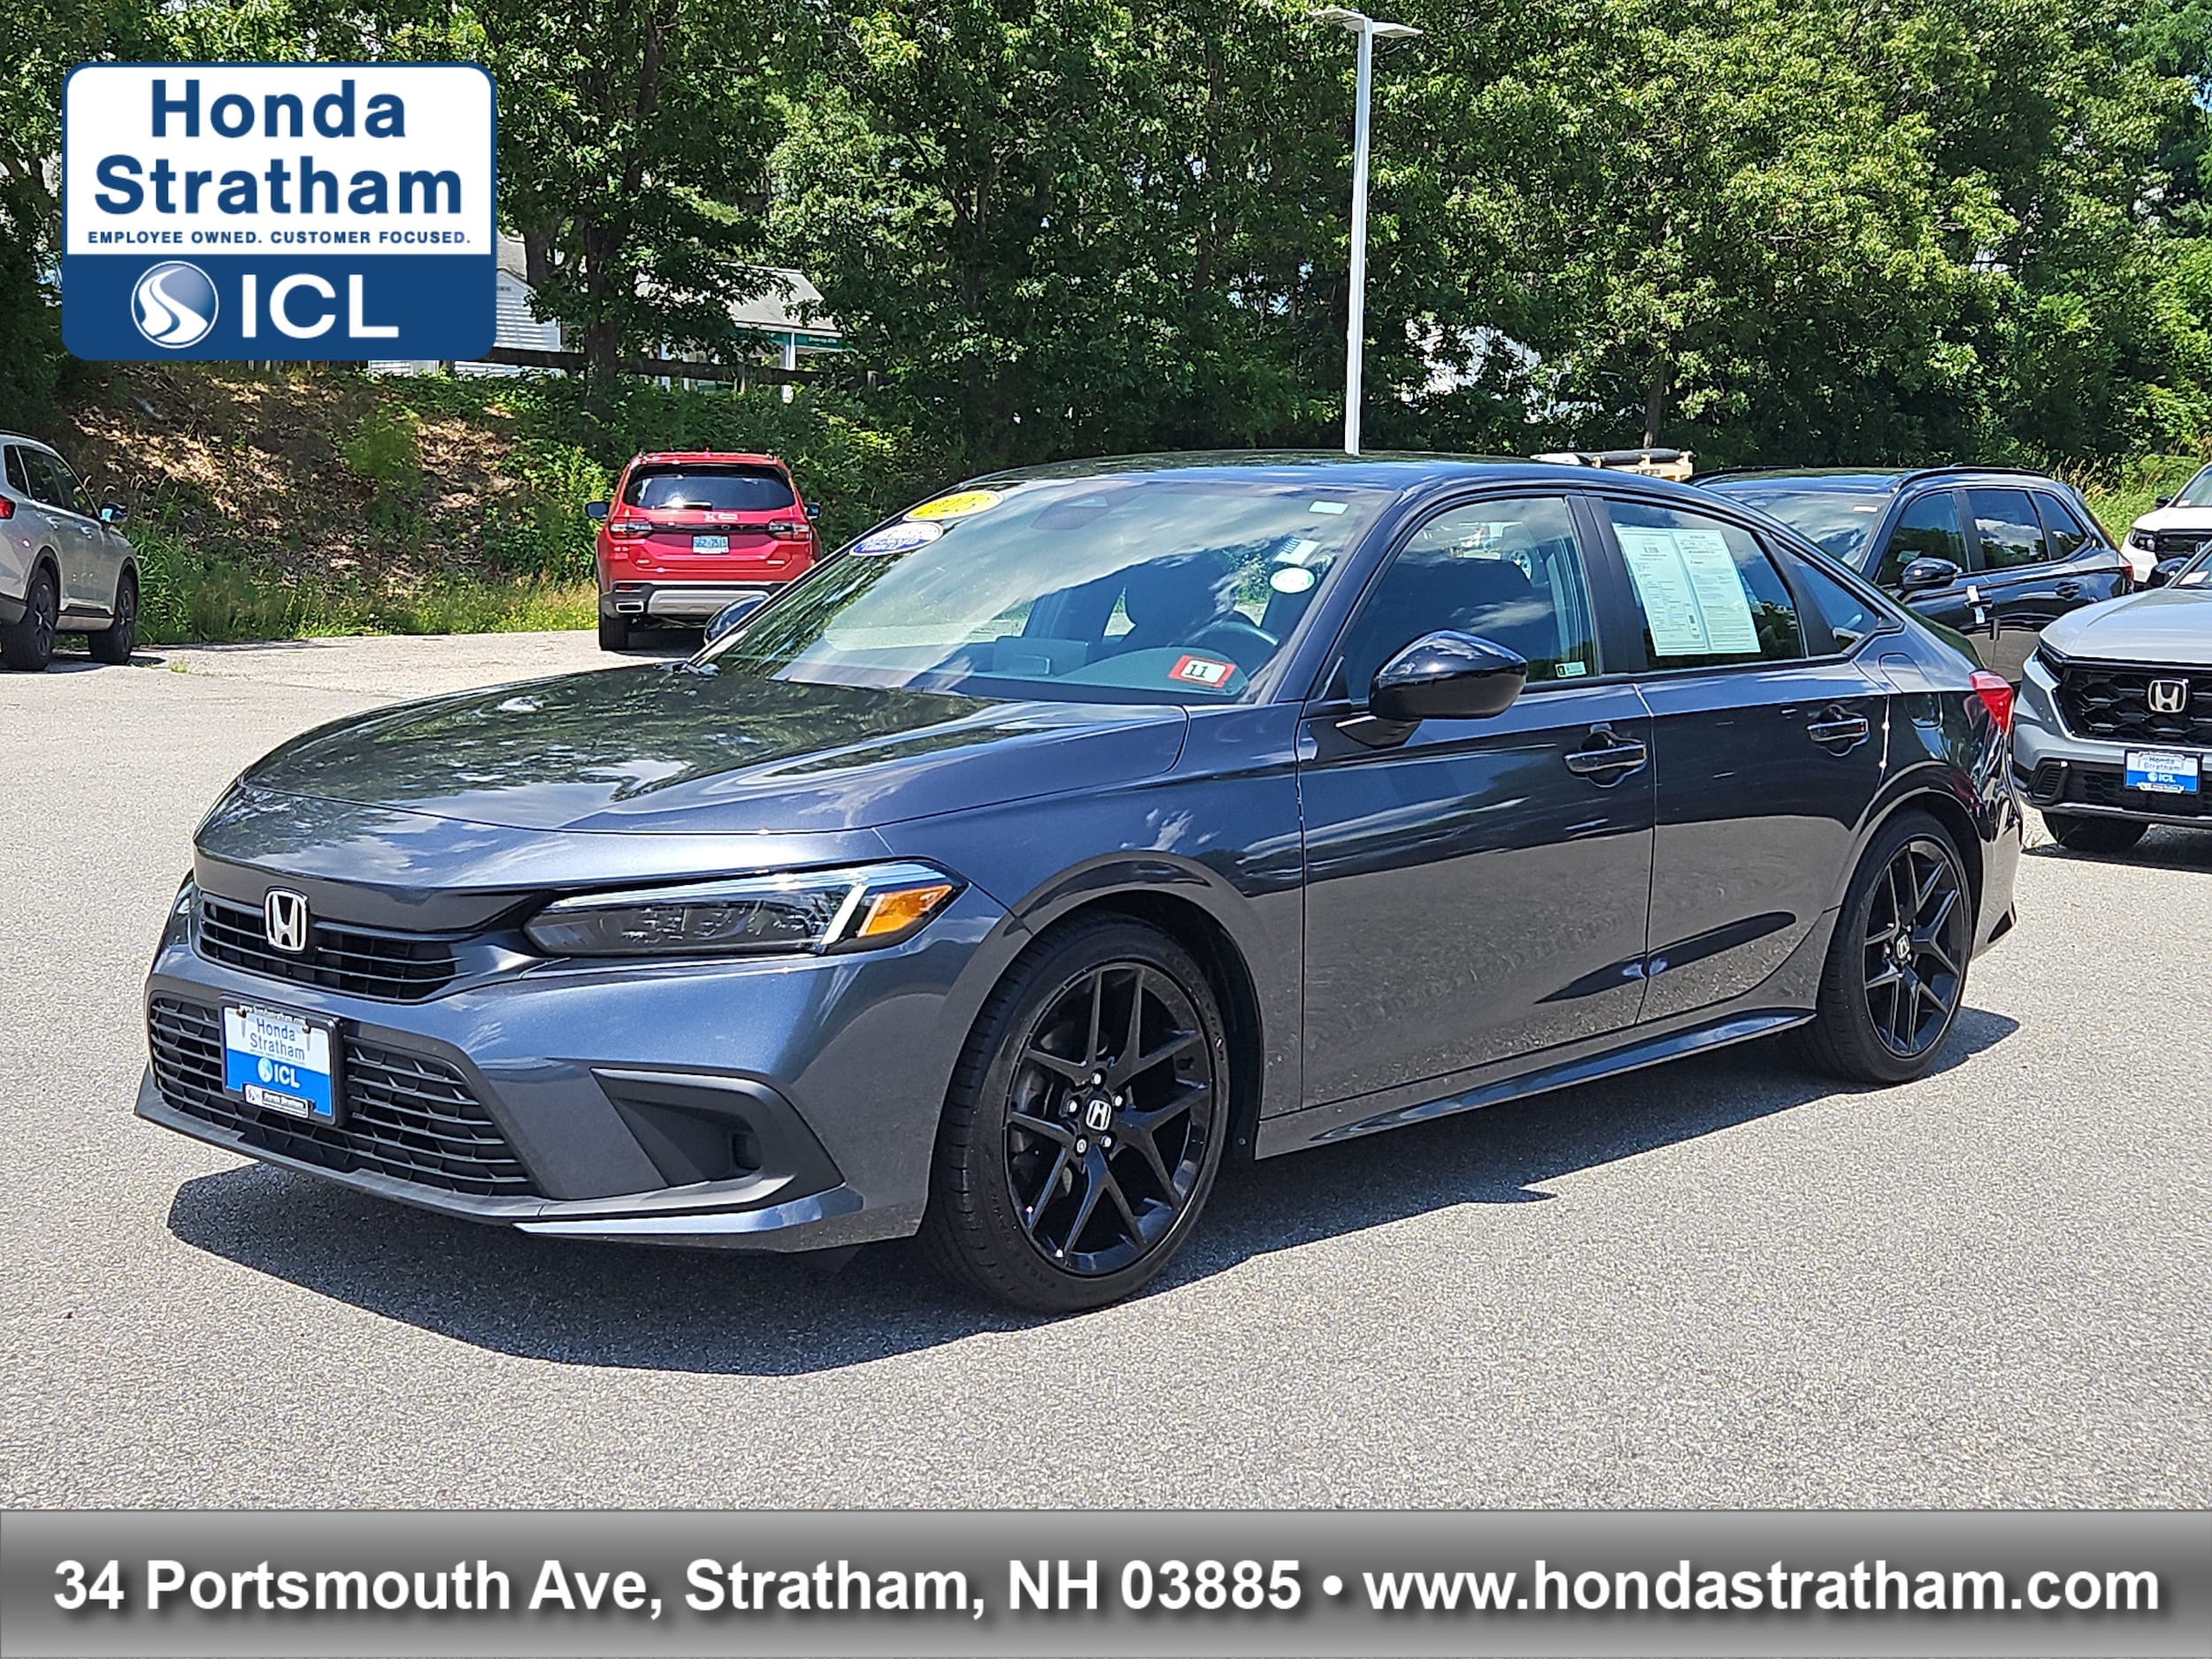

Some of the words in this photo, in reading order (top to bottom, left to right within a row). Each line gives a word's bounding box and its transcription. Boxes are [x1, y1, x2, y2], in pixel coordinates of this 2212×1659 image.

[1185, 664, 1209, 679] 11
[2159, 773, 2177, 783] ICL
[256, 1017, 296, 1042] Honda
[250, 1032, 305, 1062] Stratham
[273, 1064, 301, 1089] ICL
